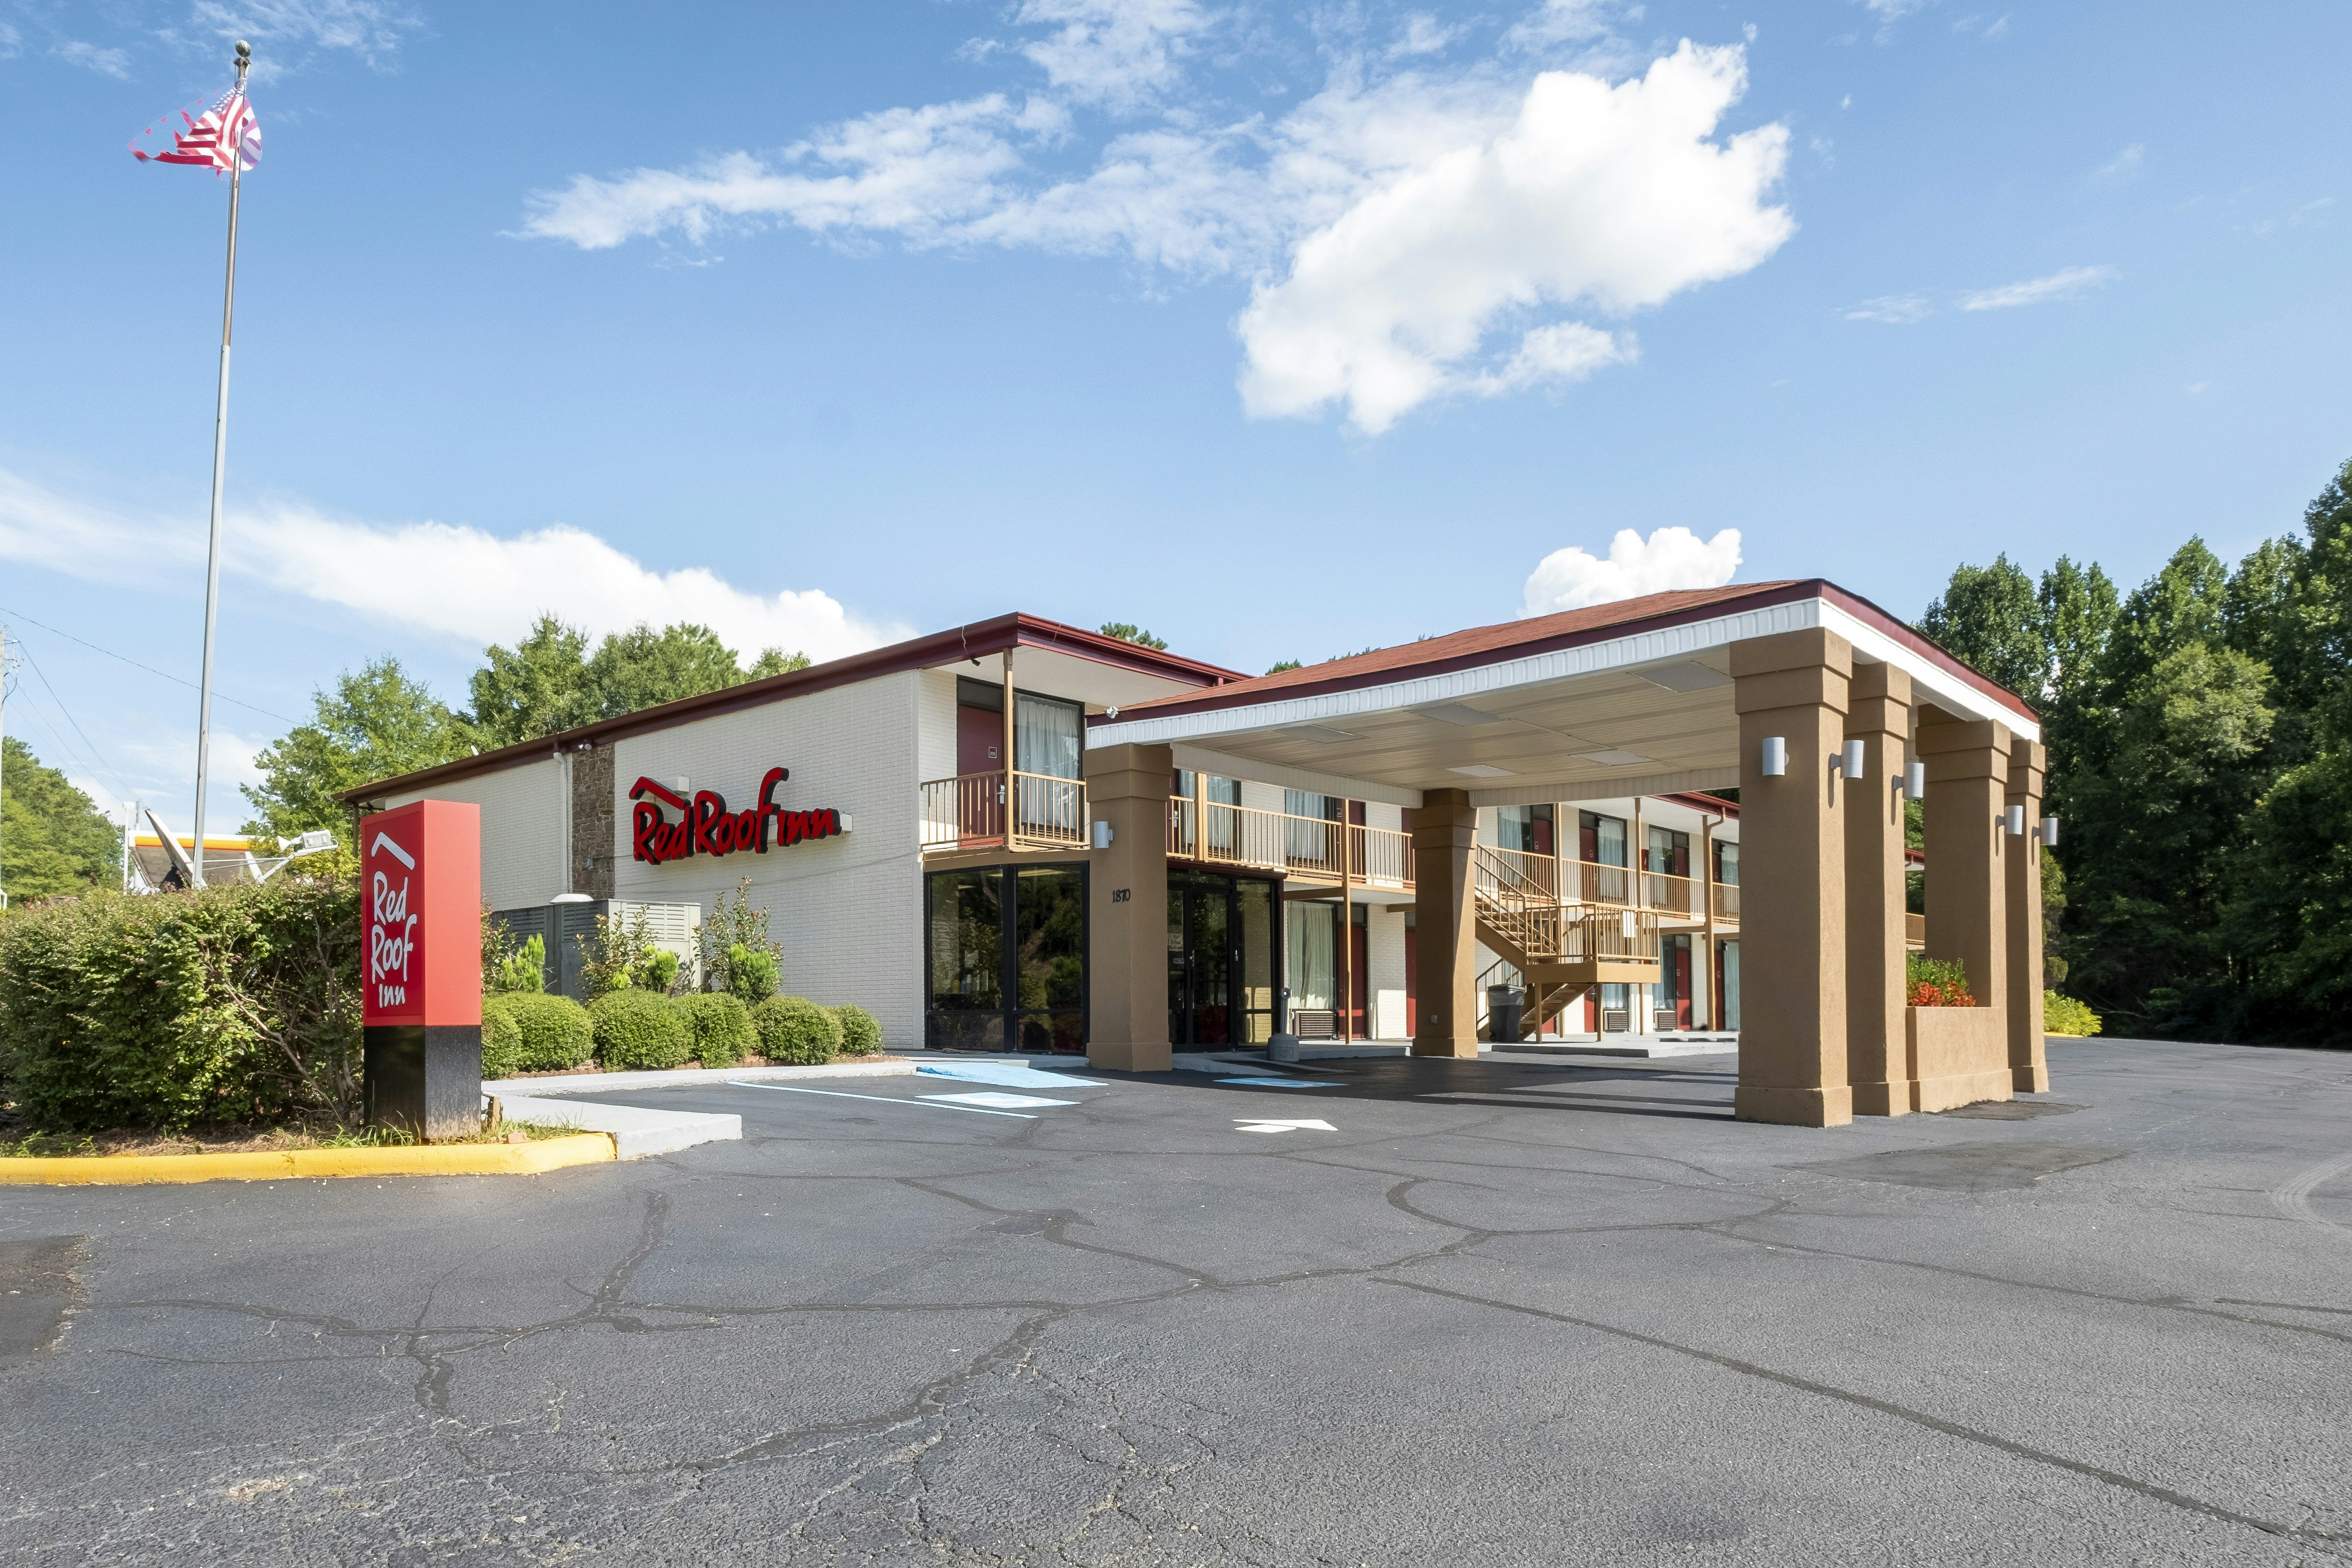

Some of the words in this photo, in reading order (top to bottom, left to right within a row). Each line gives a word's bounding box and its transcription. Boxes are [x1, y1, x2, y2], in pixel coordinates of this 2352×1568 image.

[633, 801, 694, 865] Red
[694, 767, 789, 857] Roof
[373, 870, 408, 925] Red
[1112, 888, 1131, 903] 1870
[371, 914, 417, 984] Roof
